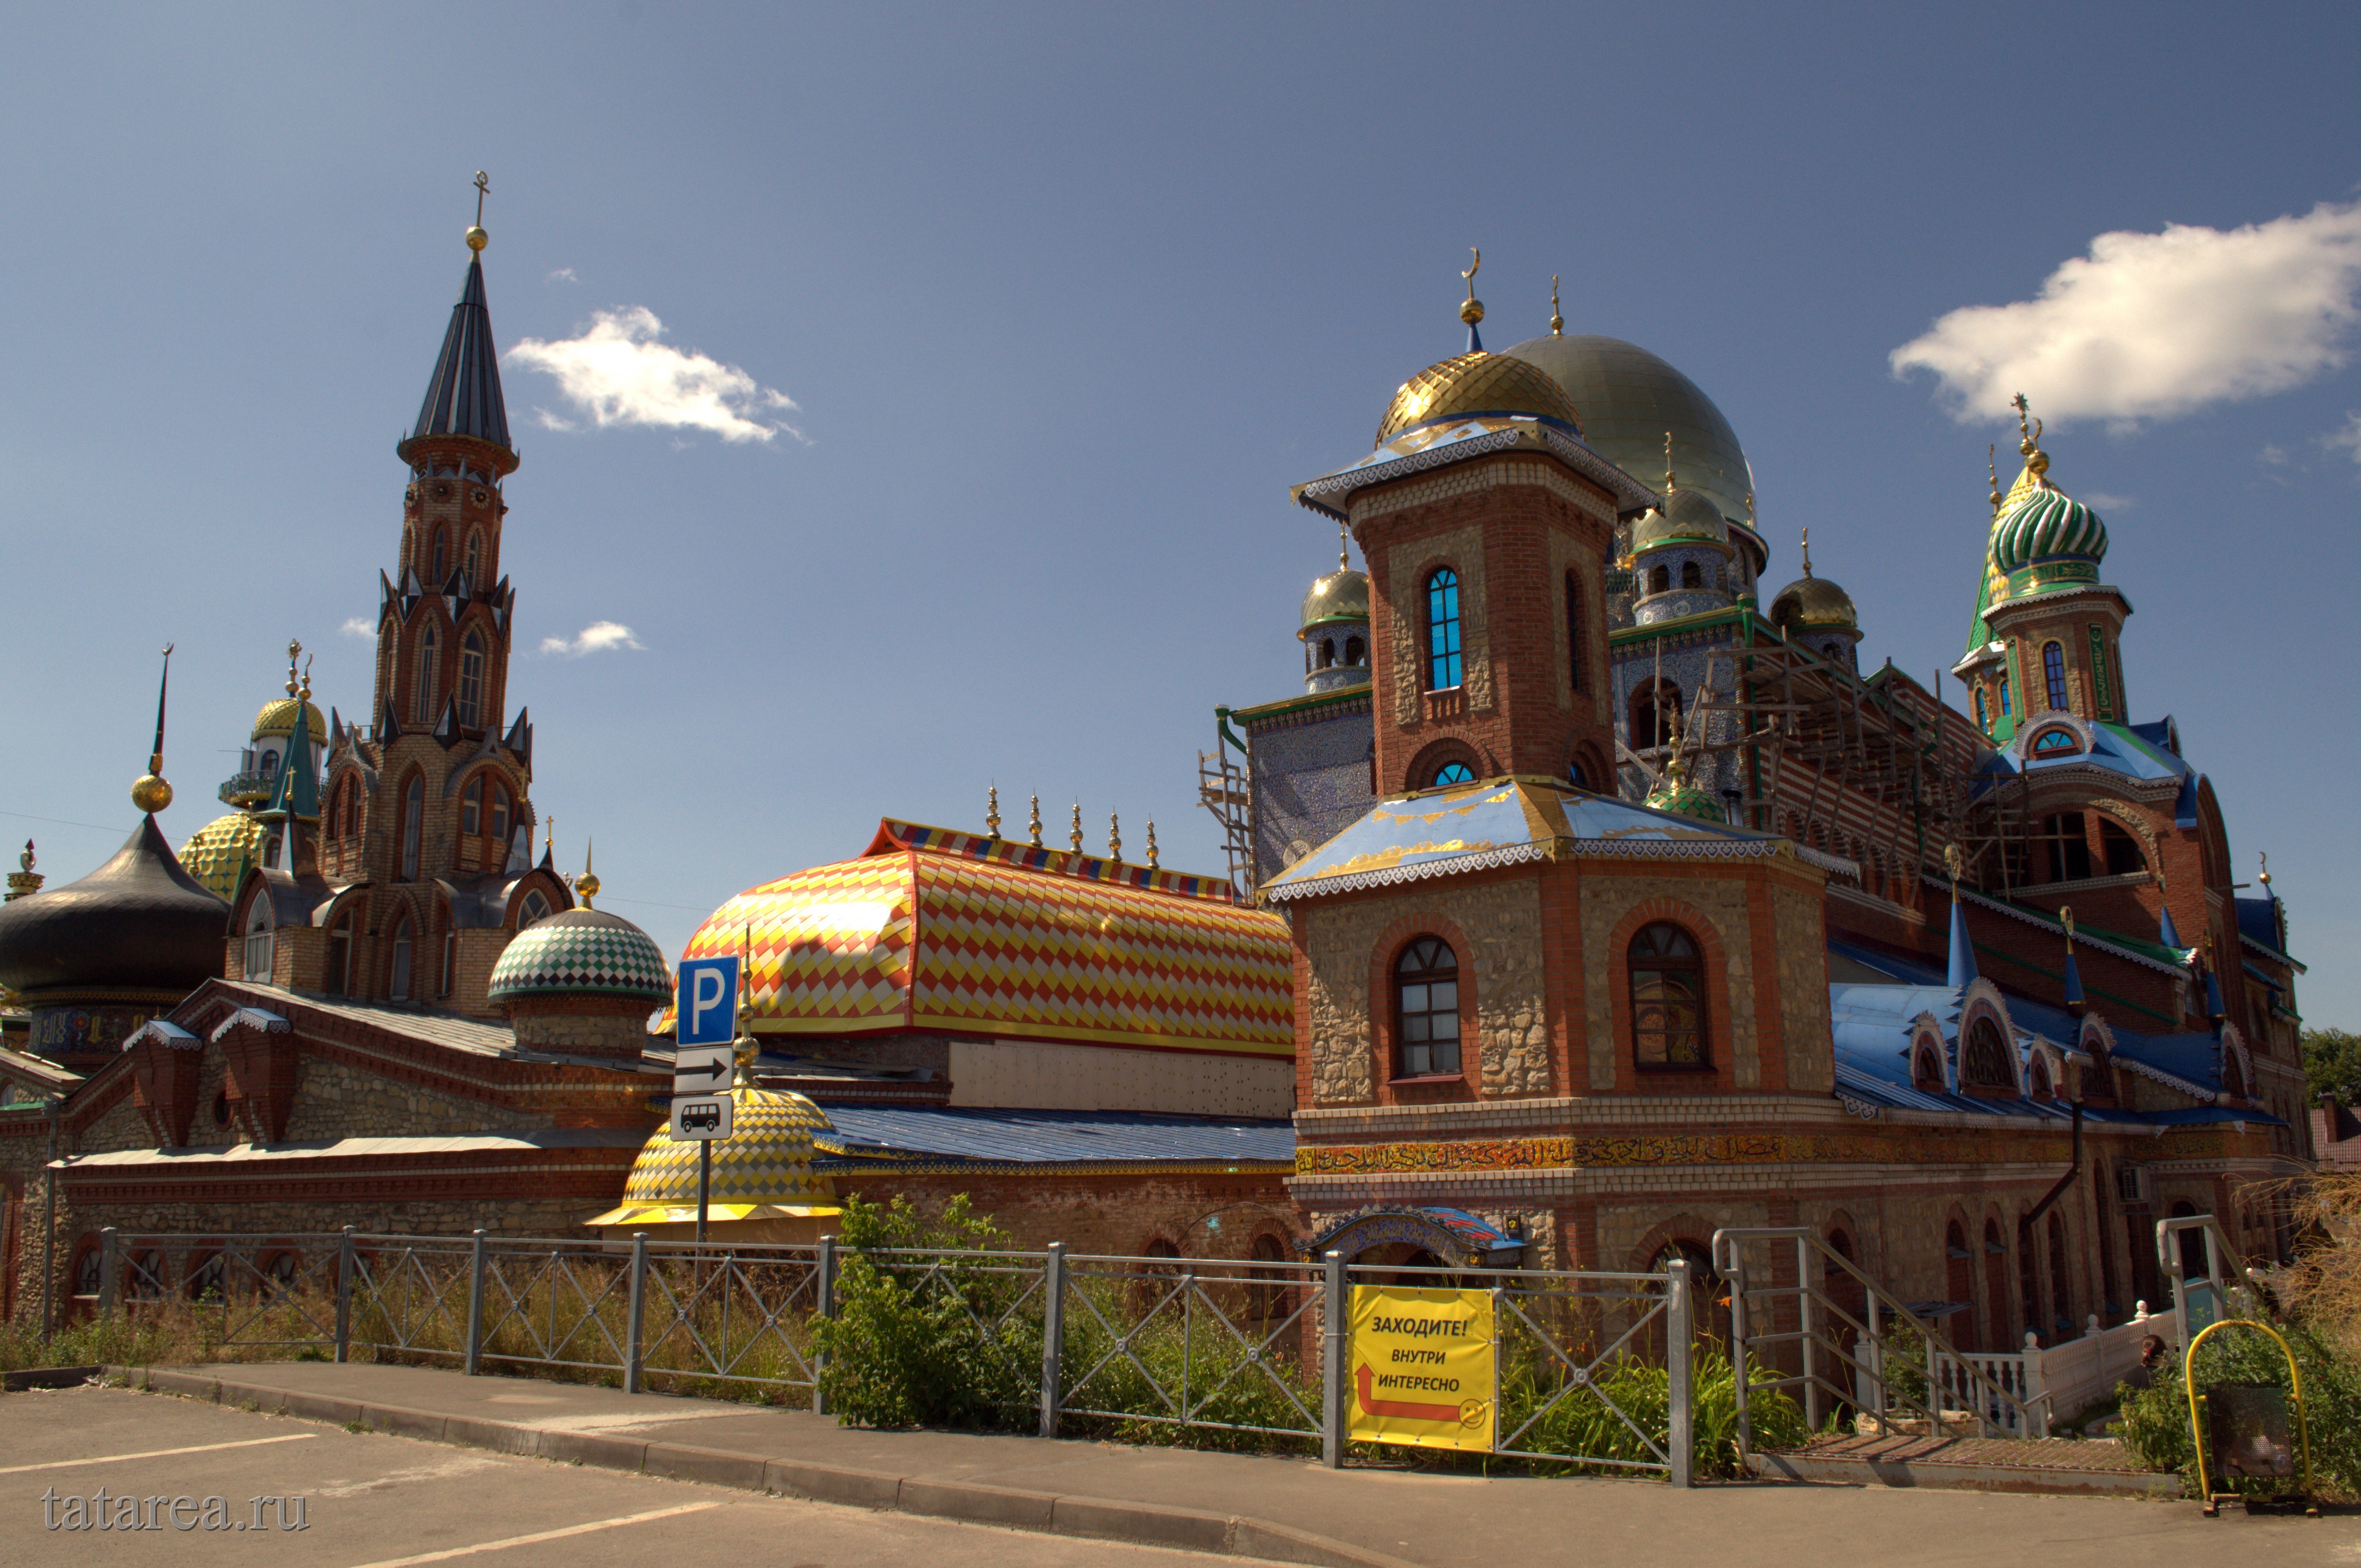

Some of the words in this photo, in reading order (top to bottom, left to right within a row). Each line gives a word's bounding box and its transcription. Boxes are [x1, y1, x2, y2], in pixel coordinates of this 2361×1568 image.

[693, 968, 725, 1035] P
[1372, 1317, 1467, 1338] ЗАХОДИТЕ!
[1391, 1349, 1445, 1365] ВНУТРИ
[1378, 1374, 1459, 1392] ИНТЕРЕСНО
